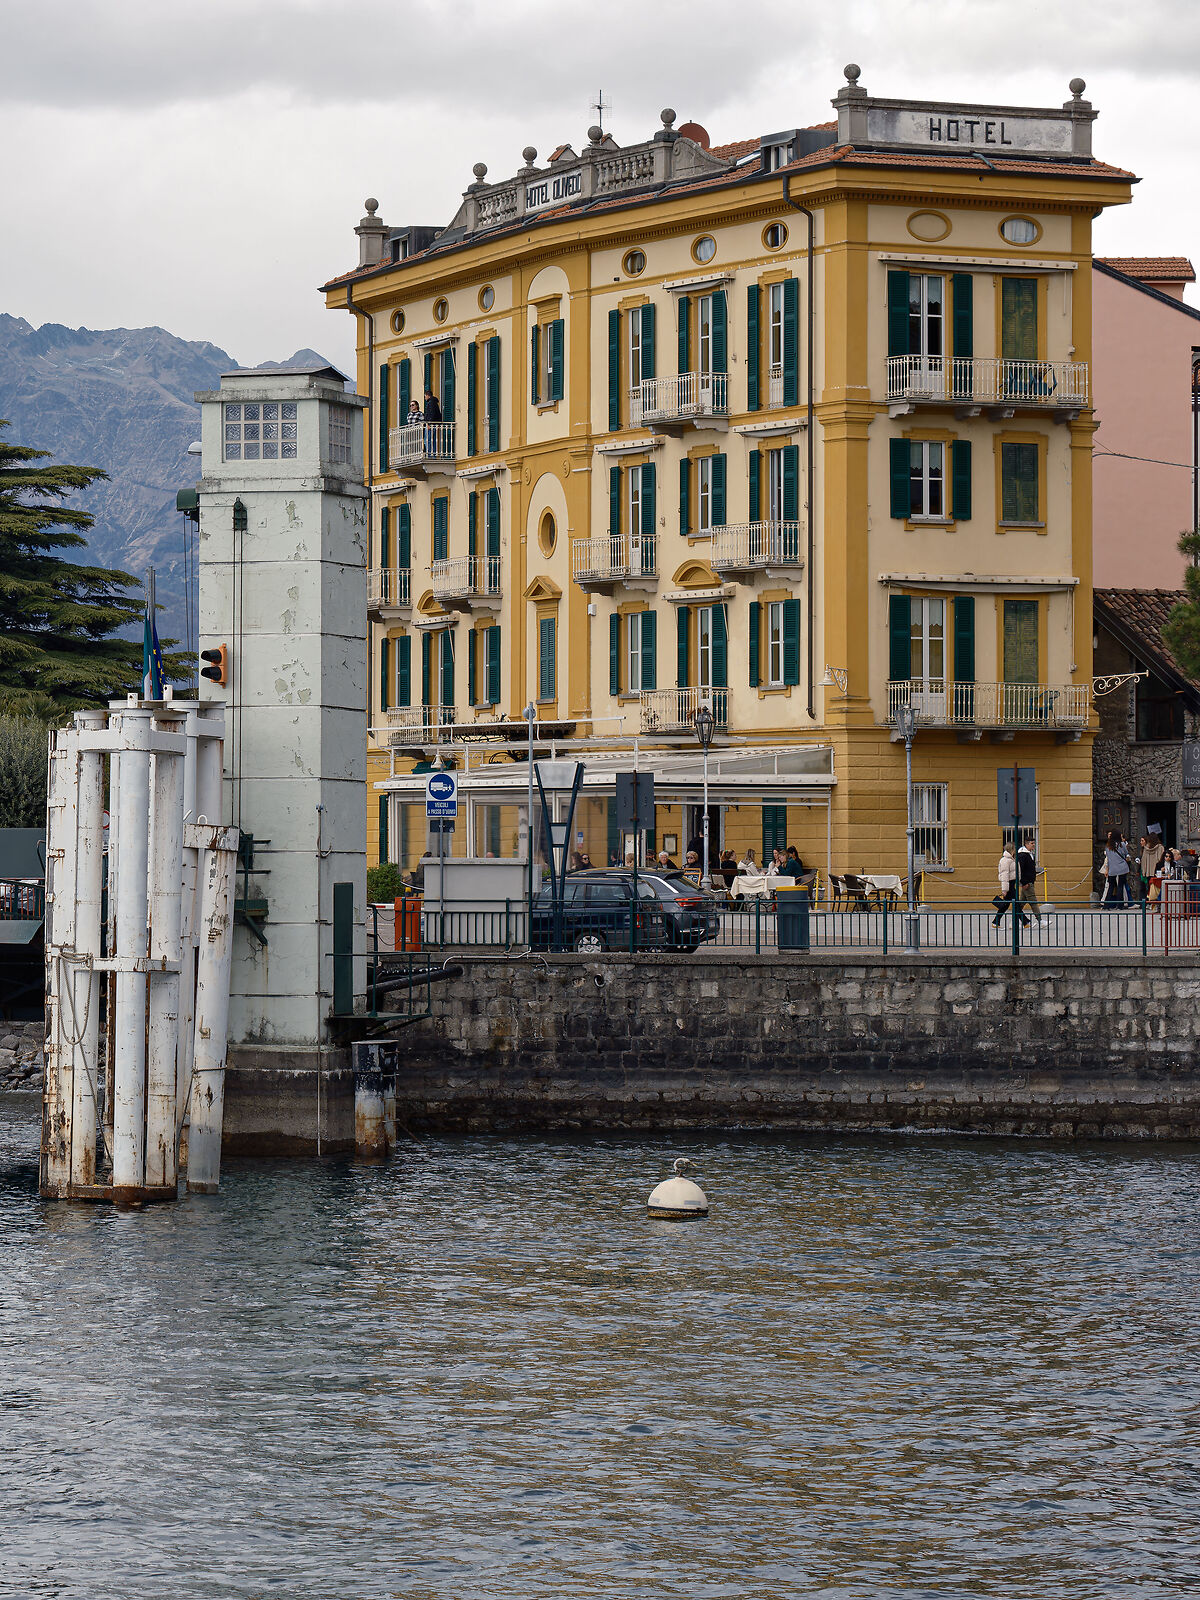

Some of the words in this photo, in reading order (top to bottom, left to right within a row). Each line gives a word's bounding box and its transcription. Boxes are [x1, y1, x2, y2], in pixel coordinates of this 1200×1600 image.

[929, 118, 1012, 144] HOTEL
[526, 183, 550, 209] HOTEL
[553, 173, 581, 200] OLIVEDO
